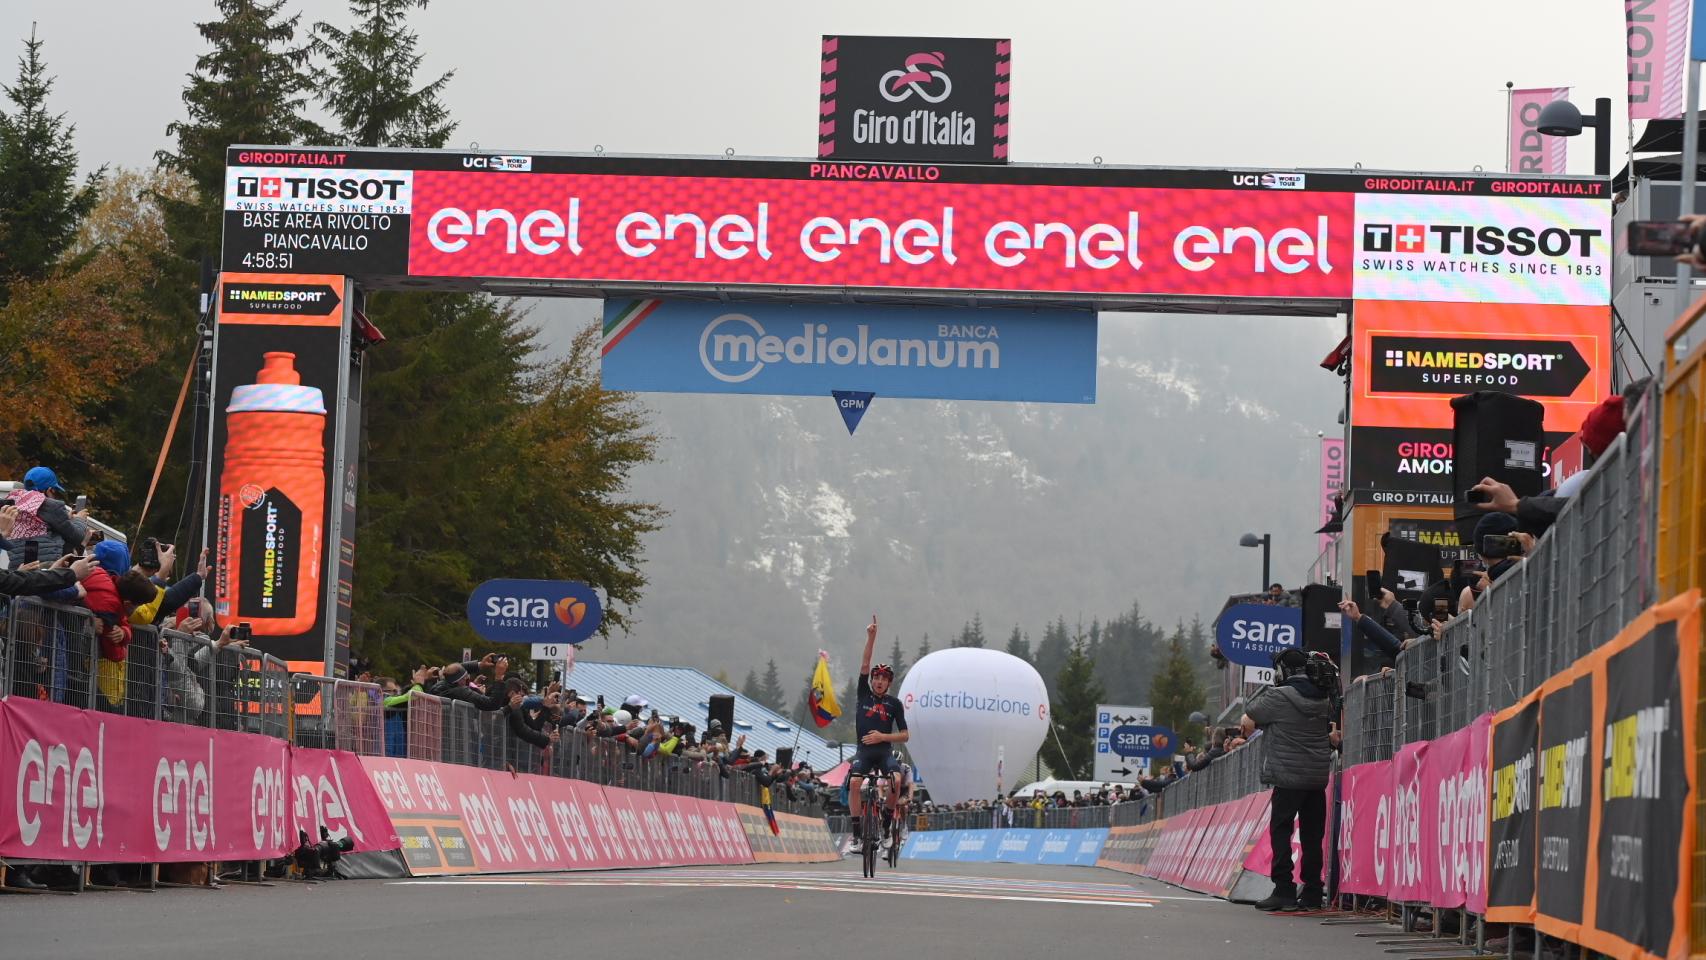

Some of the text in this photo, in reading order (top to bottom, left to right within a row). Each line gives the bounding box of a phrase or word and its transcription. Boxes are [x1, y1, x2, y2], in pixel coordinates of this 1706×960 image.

[853, 109, 975, 146] Giro d'Italia
[239, 152, 347, 166] GIRODITALIA.IT
[463, 157, 487, 169] UCI
[810, 164, 940, 181] PIANCAVALLO
[1233, 175, 1258, 186] UCI
[285, 178, 405, 201] TISSOT
[1364, 178, 1601, 195] GIRODITALIA.IT GIRODITALIA.IT
[236, 201, 405, 214] SWISS WATCHES SINCE 1853
[243, 212, 391, 231] BASE AREA RIVOLTO
[264, 233, 368, 250] PIANCAVALLO
[427, 197, 1334, 275] enel enel enel enel enel
[1430, 225, 1602, 257] TISSOT
[242, 252, 293, 269] 4:58:51
[1363, 259, 1602, 277] SWISS WATCHES SINCE 1853
[250, 302, 302, 310] SUPERFOOD
[938, 324, 999, 339] BANCA
[713, 322, 999, 369] mediolanum
[1422, 373, 1519, 386] SUPERFOOD
[840, 398, 864, 409] GPM
[1373, 493, 1403, 503] GIRO
[275, 528, 285, 587] SUPERFOOD
[485, 596, 549, 619] sara
[500, 619, 549, 628] ASSICURA
[1231, 619, 1296, 646] sara
[543, 646, 557, 657] 10
[1257, 671, 1272, 682] 10
[904, 690, 1031, 716] e-distribuzione
[1117, 733, 1150, 746] sara
[17, 720, 104, 848] enel
[153, 738, 216, 851] enel
[251, 748, 287, 850] enel
[373, 760, 452, 812] enel enel
[459, 775, 518, 864] enel
[508, 780, 560, 863] enel
[551, 785, 599, 861] enel
